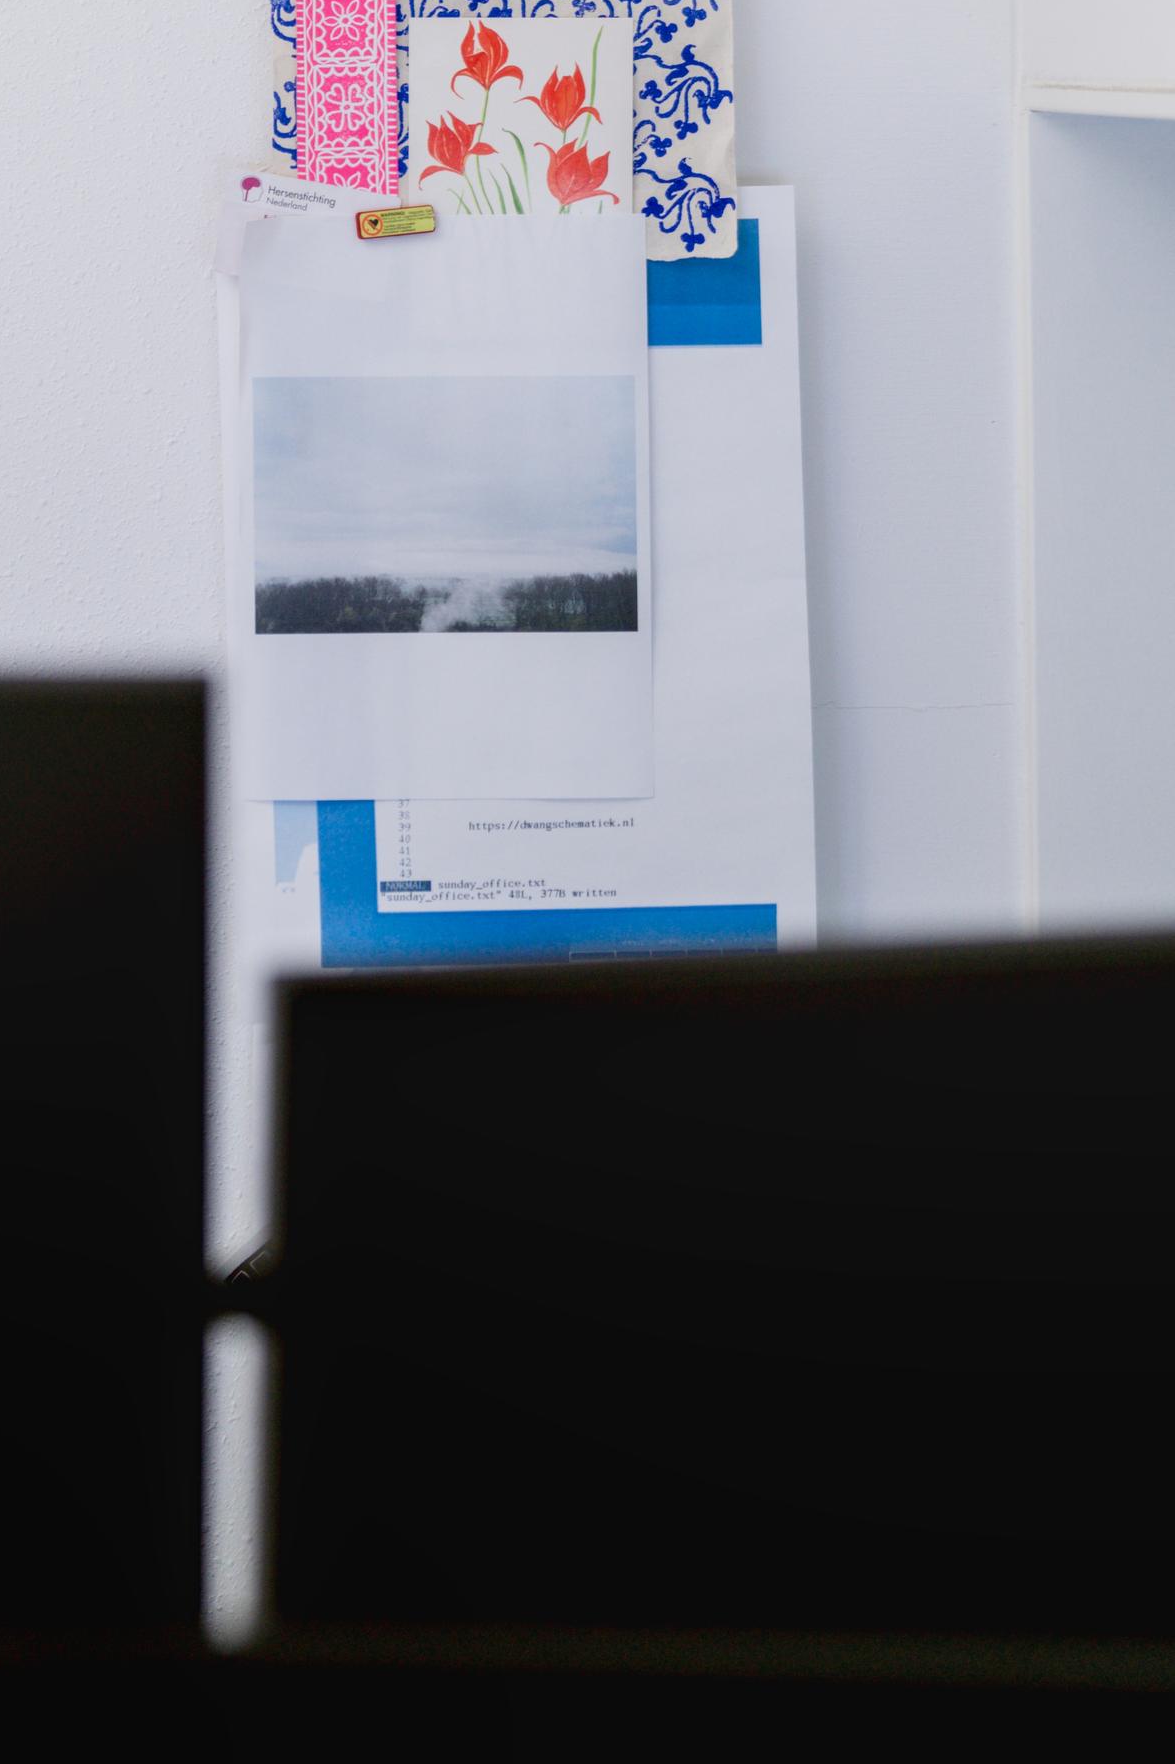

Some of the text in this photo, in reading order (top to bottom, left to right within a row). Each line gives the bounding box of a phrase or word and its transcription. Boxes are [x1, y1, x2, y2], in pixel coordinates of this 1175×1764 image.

[268, 185, 336, 208] Hersenstichting
[266, 197, 308, 211] Nederland
[438, 879, 545, 891] sunday_office.txt
[572, 888, 617, 898] written
